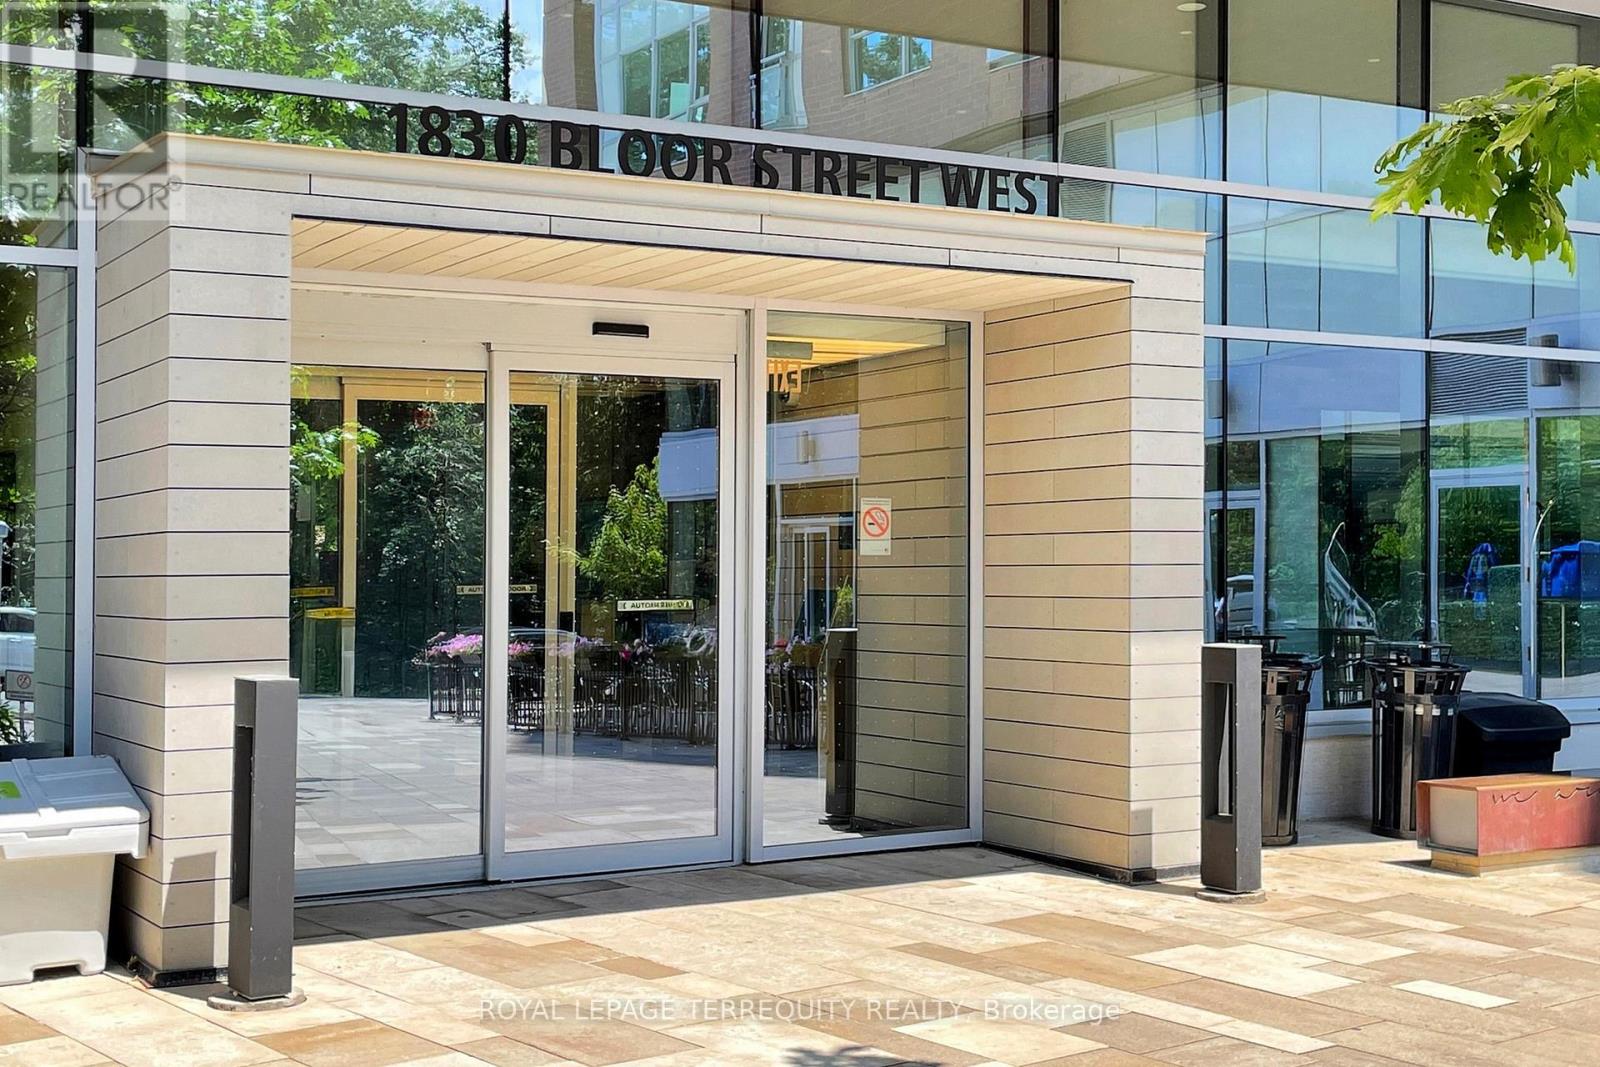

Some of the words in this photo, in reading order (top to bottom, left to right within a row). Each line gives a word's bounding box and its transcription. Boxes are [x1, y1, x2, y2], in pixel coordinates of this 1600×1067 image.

[386, 102, 527, 165] 1830
[551, 120, 734, 186] BLOOR
[753, 144, 929, 204] STREET
[939, 163, 1064, 218] WEST
